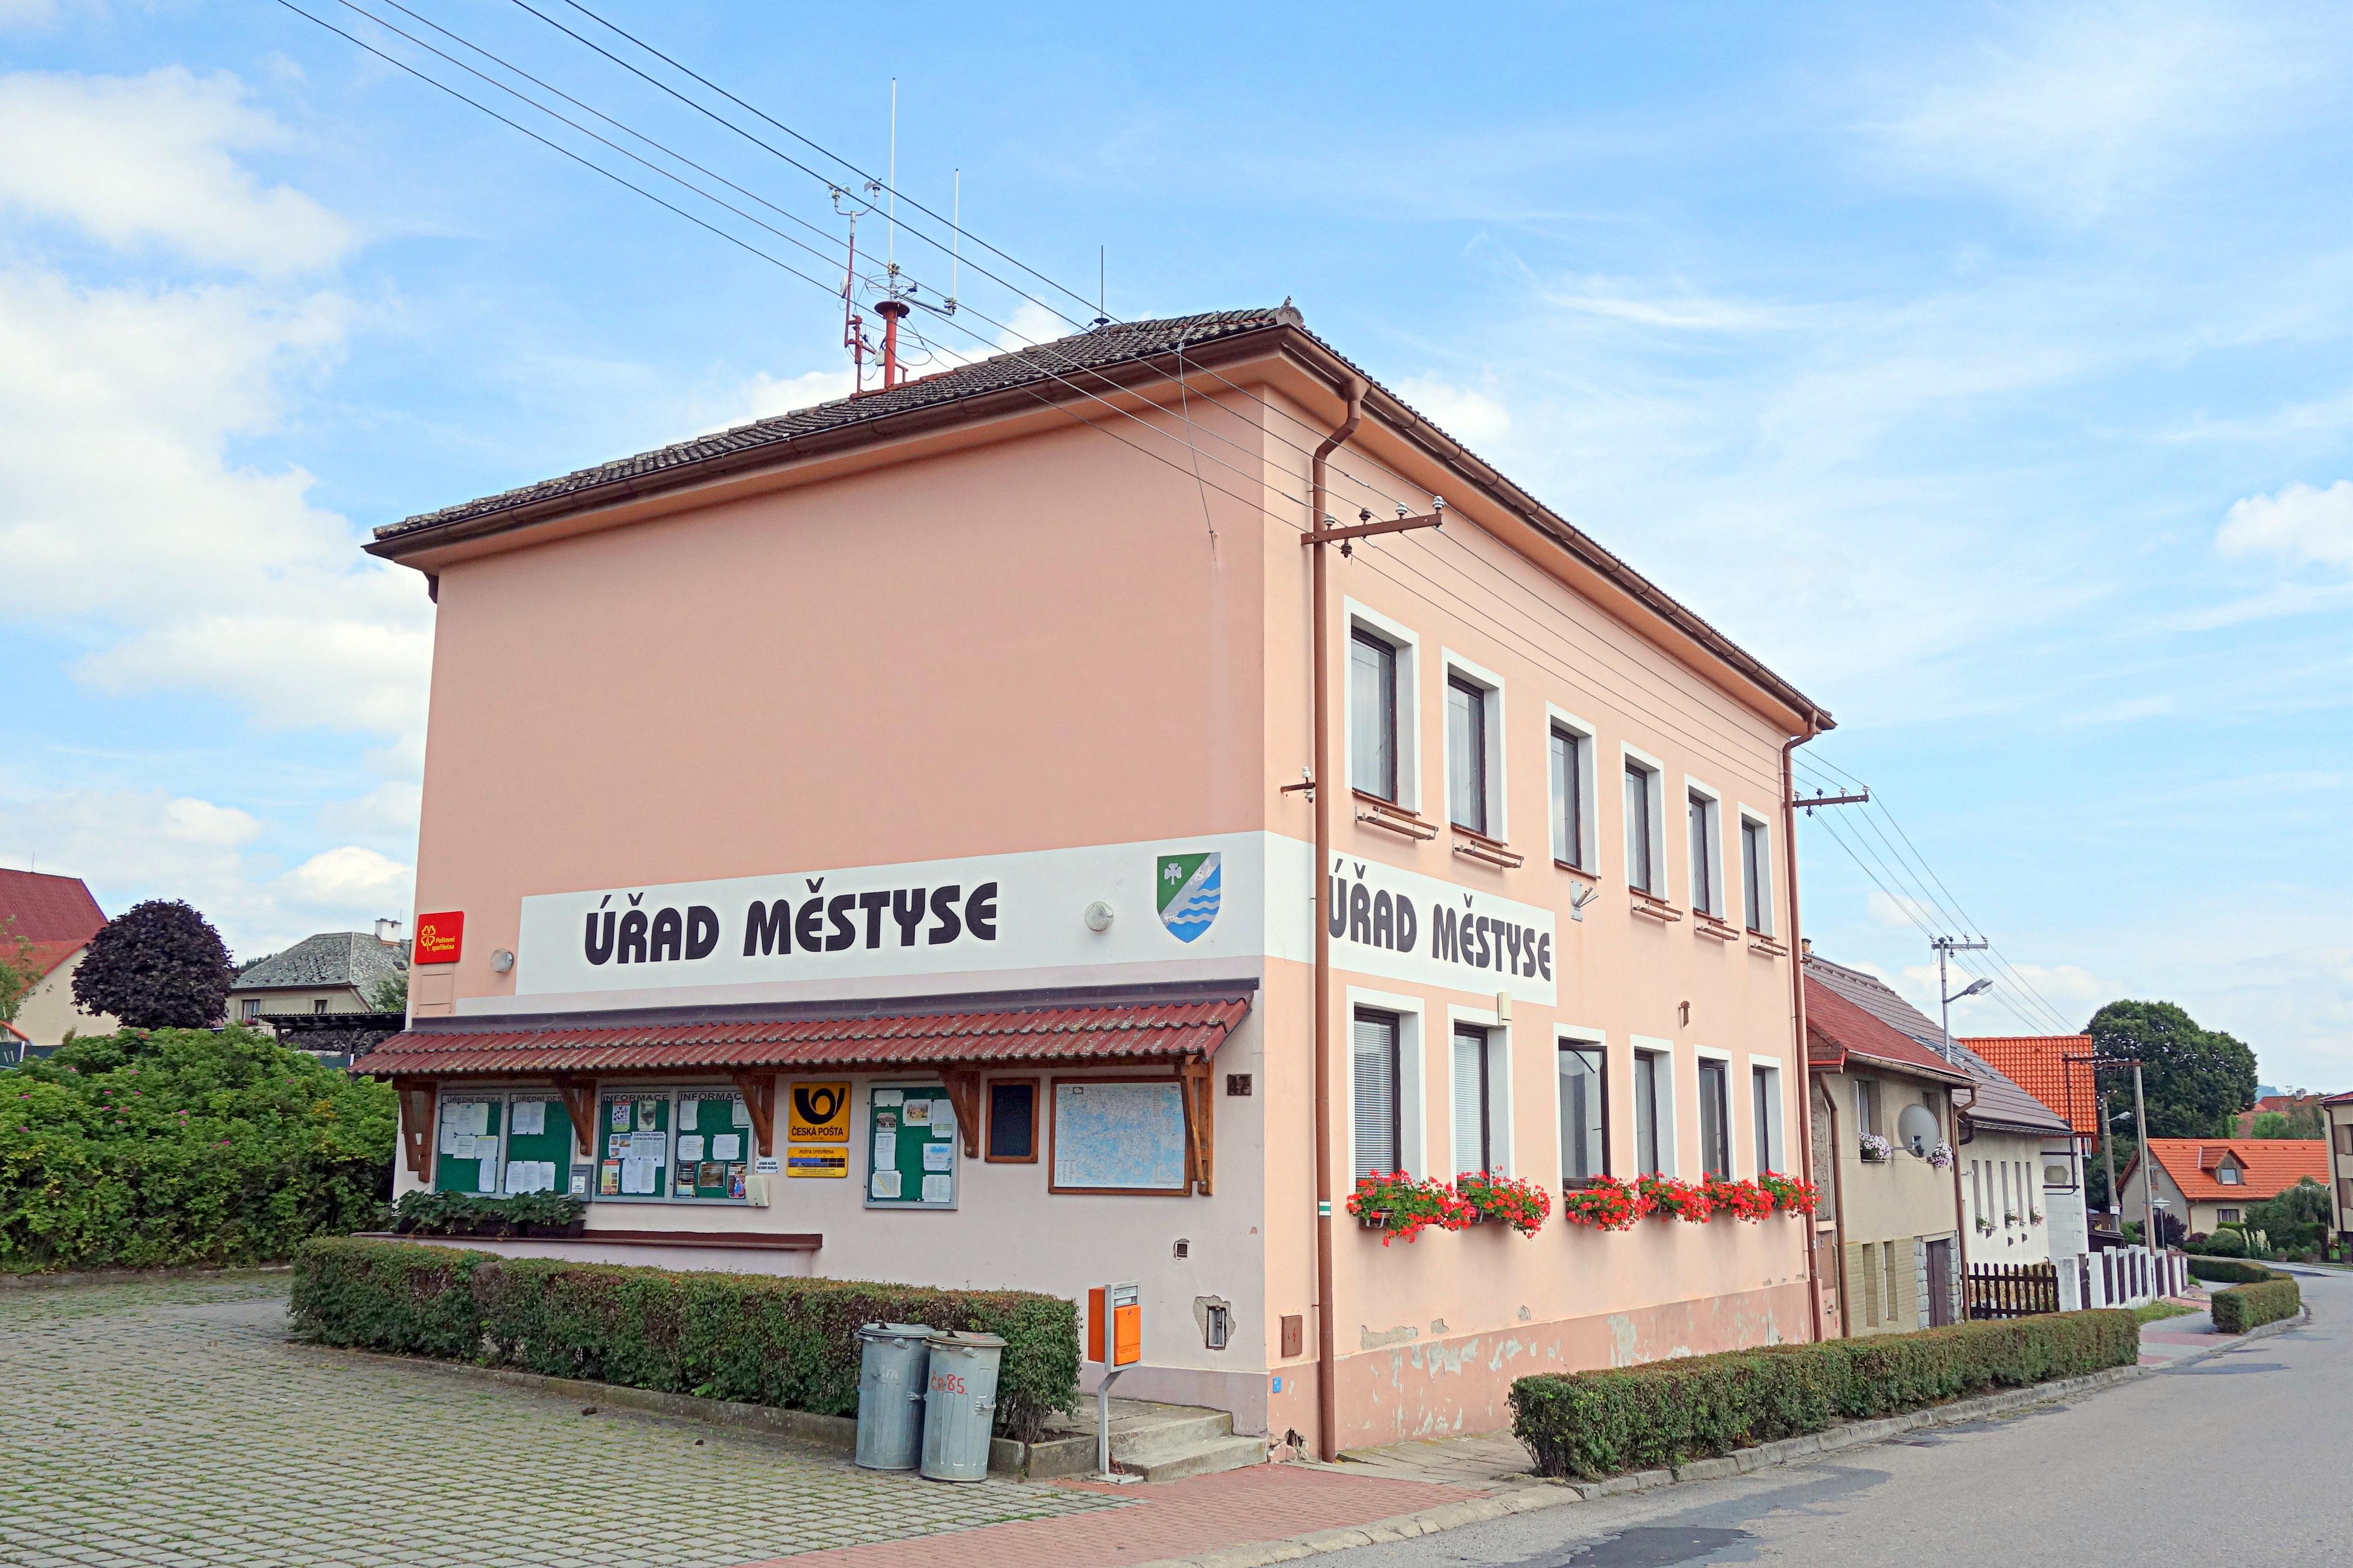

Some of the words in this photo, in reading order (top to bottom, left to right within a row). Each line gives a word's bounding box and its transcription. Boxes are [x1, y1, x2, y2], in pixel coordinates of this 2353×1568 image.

[585, 892, 719, 966] ÚŘAD
[743, 876, 998, 957] MĚSTYSE
[1329, 859, 1417, 953] ÚŘAD
[1432, 893, 1551, 982] MĚSTYSE
[680, 1092, 744, 1100] INFORMAC
[791, 1126, 816, 1136] ČESKÁ
[818, 1126, 844, 1136] POŠTA
[946, 1373, 965, 1394] 85
